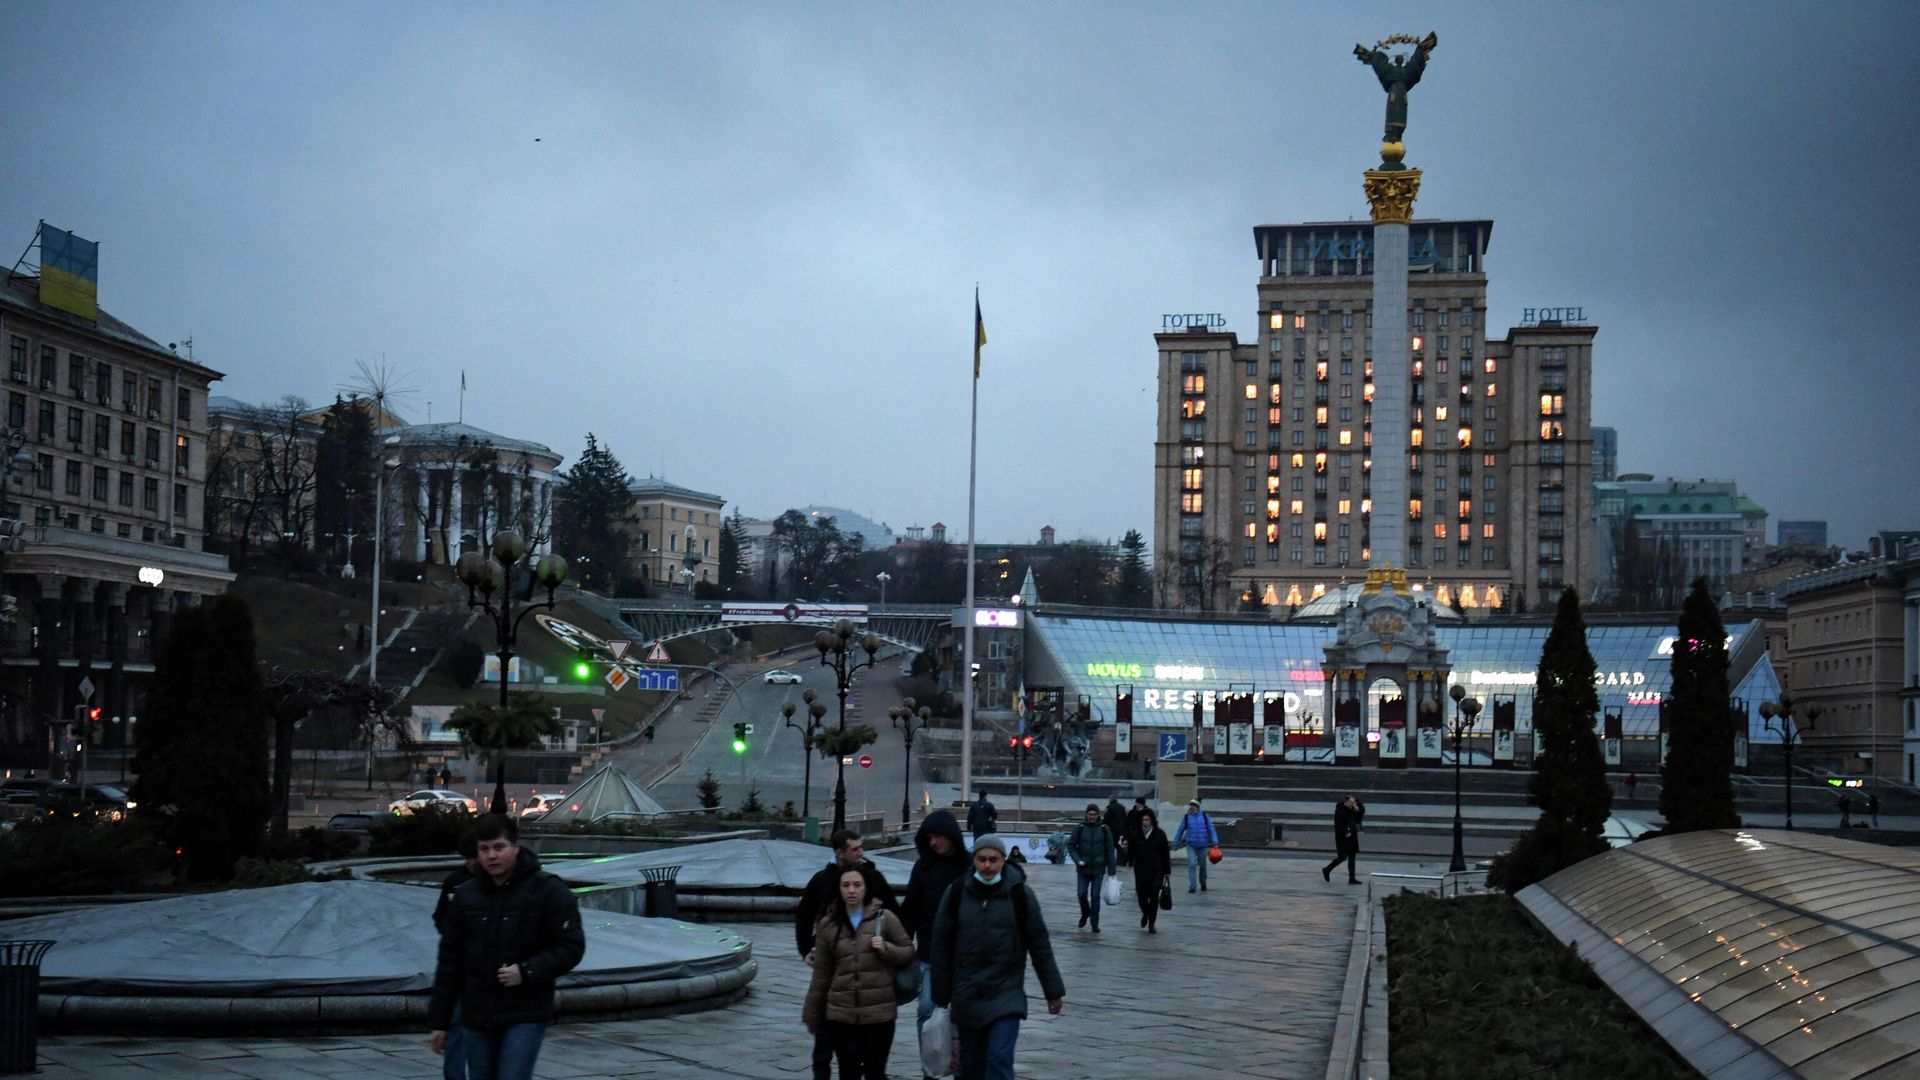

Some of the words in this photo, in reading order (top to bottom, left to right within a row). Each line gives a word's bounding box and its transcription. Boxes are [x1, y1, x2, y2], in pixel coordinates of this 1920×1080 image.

[1162, 313, 1226, 328] ГОТЕЛЬ
[1523, 307, 1588, 322] HOTEL
[1088, 662, 1141, 679] NOVUS
